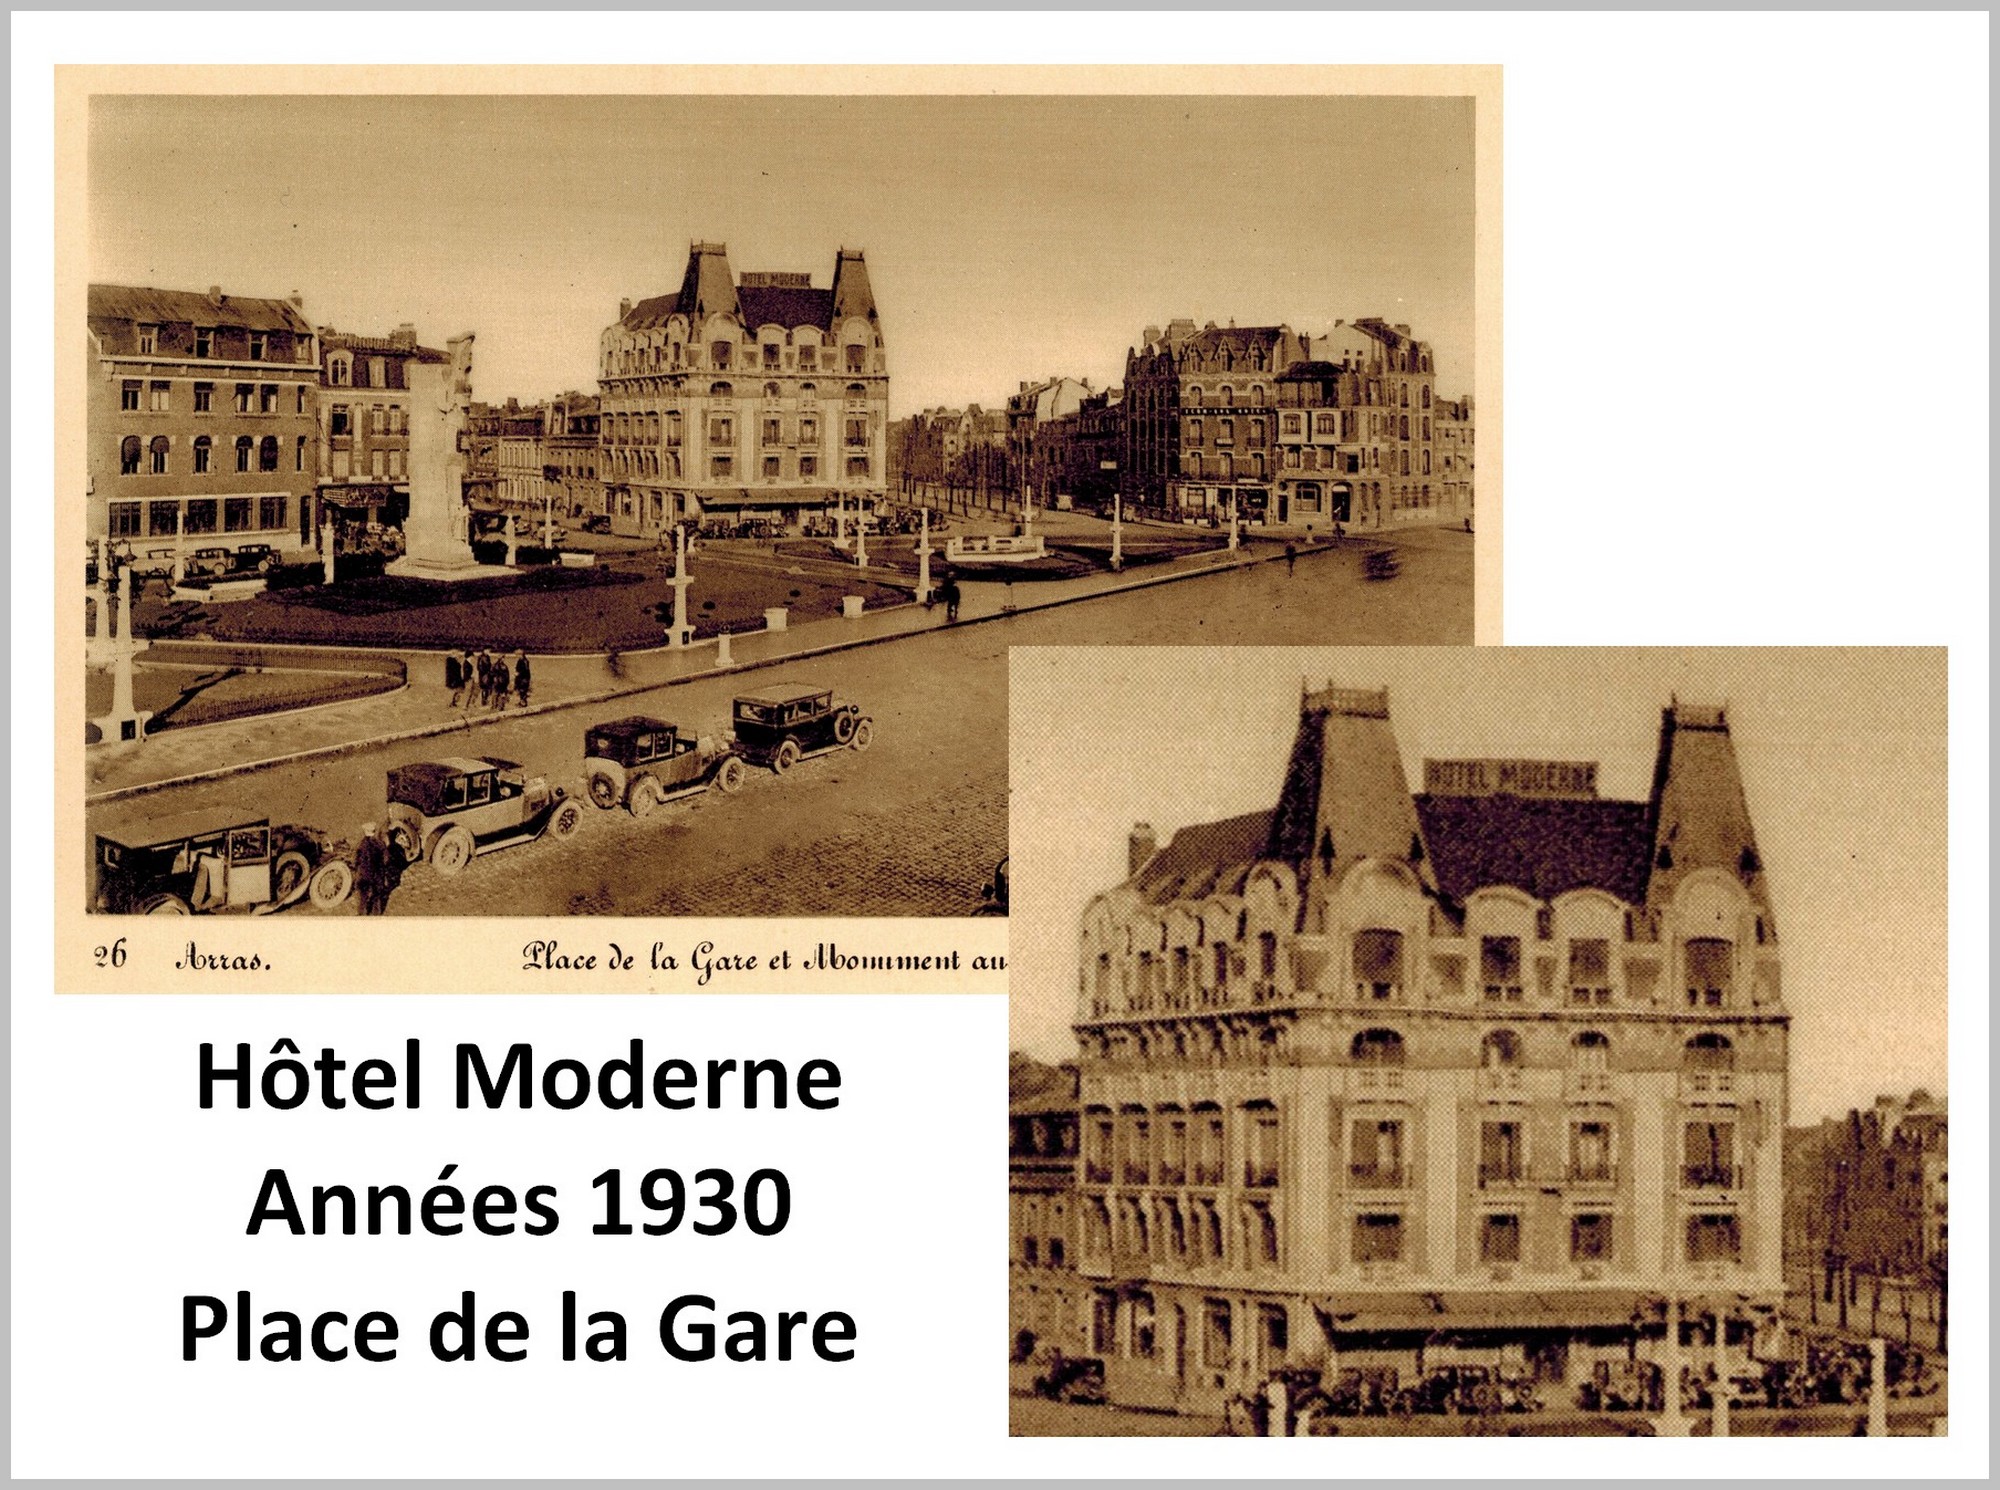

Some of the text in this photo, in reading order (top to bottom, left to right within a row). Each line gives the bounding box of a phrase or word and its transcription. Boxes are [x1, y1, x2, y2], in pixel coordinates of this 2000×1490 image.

[740, 272, 811, 288] HOTEL MODERNE
[1427, 760, 1598, 795] HOTEL MODERNE
